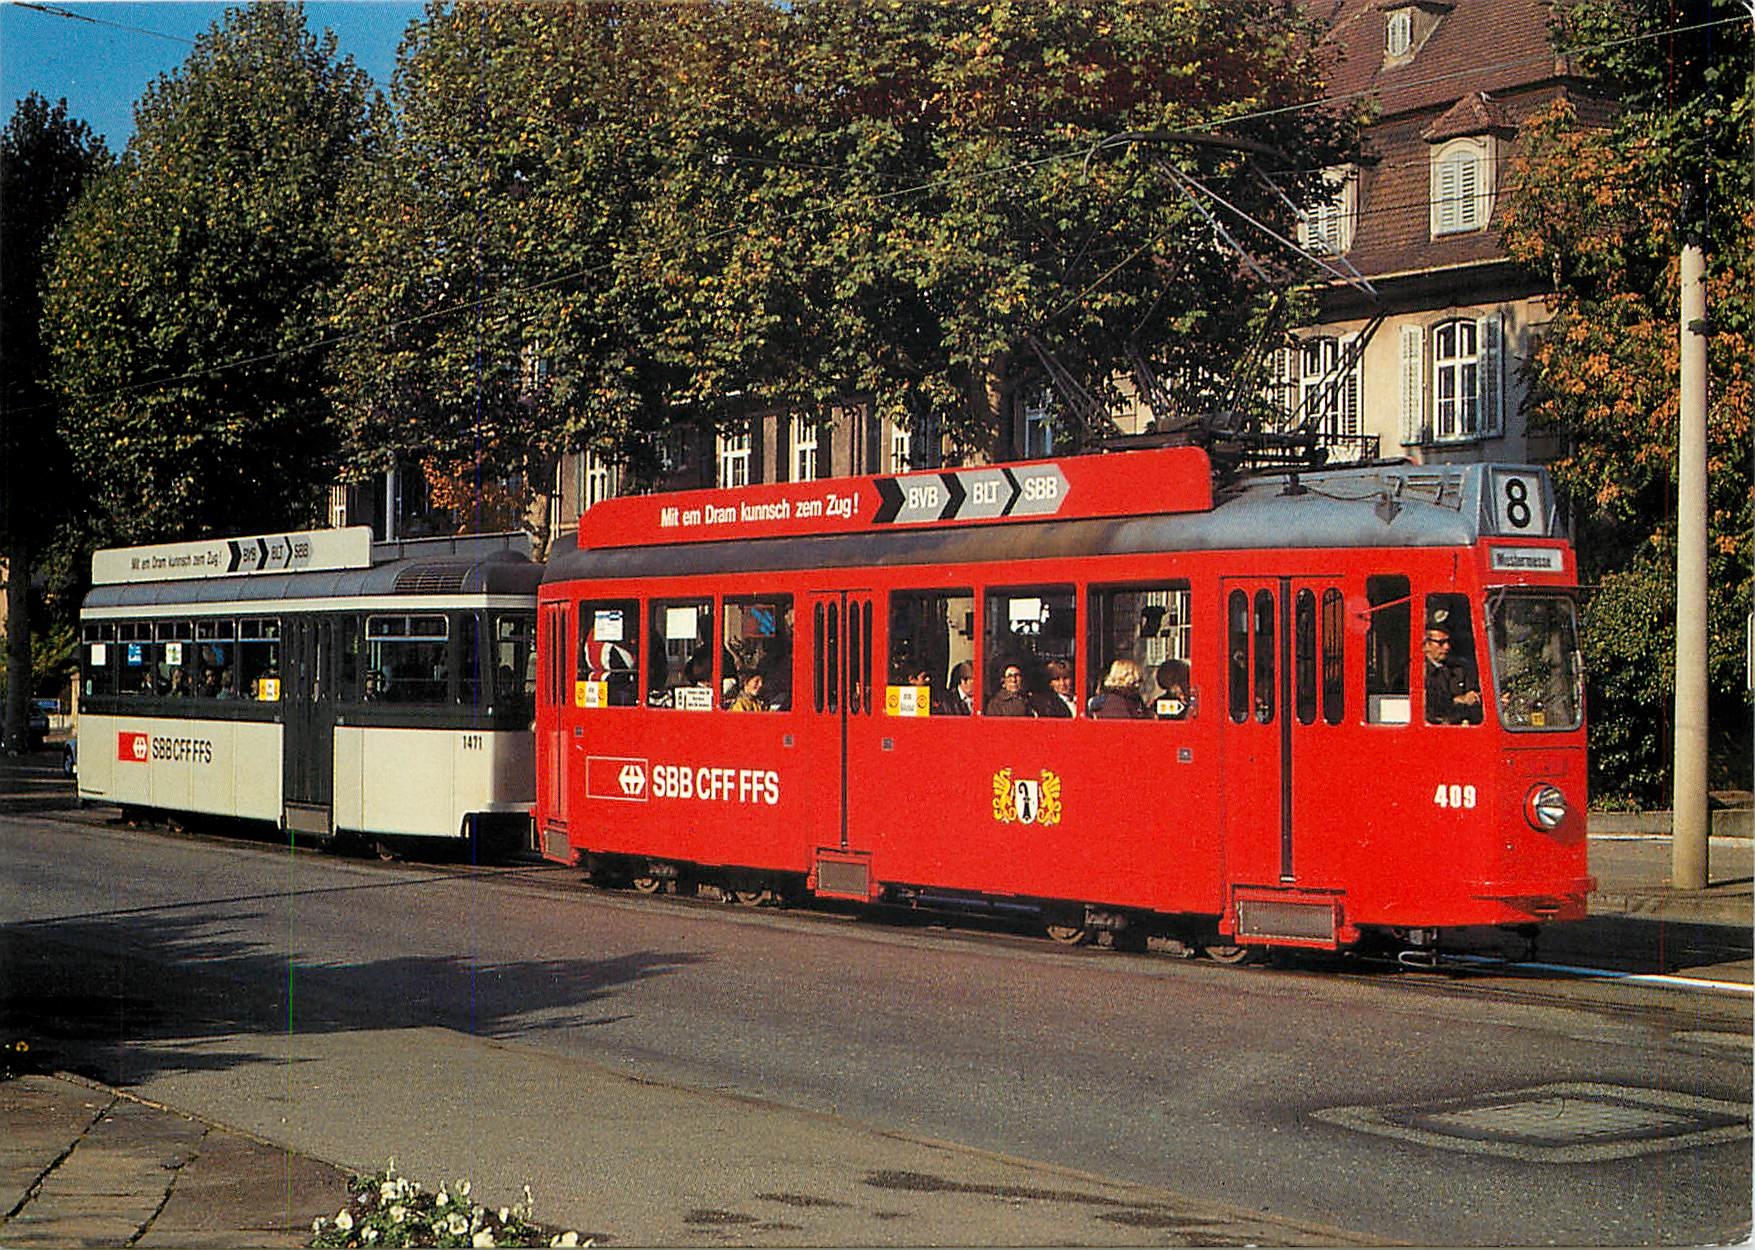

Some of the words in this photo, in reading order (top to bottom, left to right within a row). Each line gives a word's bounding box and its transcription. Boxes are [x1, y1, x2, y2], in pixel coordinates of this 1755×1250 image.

[909, 486, 939, 509] BVB
[973, 480, 1000, 504] BLT
[1024, 476, 1058, 501] SBB
[661, 507, 679, 528] Mit
[682, 511, 701, 526] em
[705, 504, 737, 524] Dram
[740, 499, 790, 523] kunnsch
[796, 500, 822, 518] zem
[1505, 478, 1531, 529] 8
[243, 547, 256, 562] BVB
[272, 544, 284, 560] BLT
[294, 543, 308, 559] SBB
[463, 735, 482, 750] 1471
[652, 764, 694, 799] SBB
[696, 767, 736, 801] CFF
[739, 769, 779, 805] FFS
[1433, 784, 1477, 809] 409
